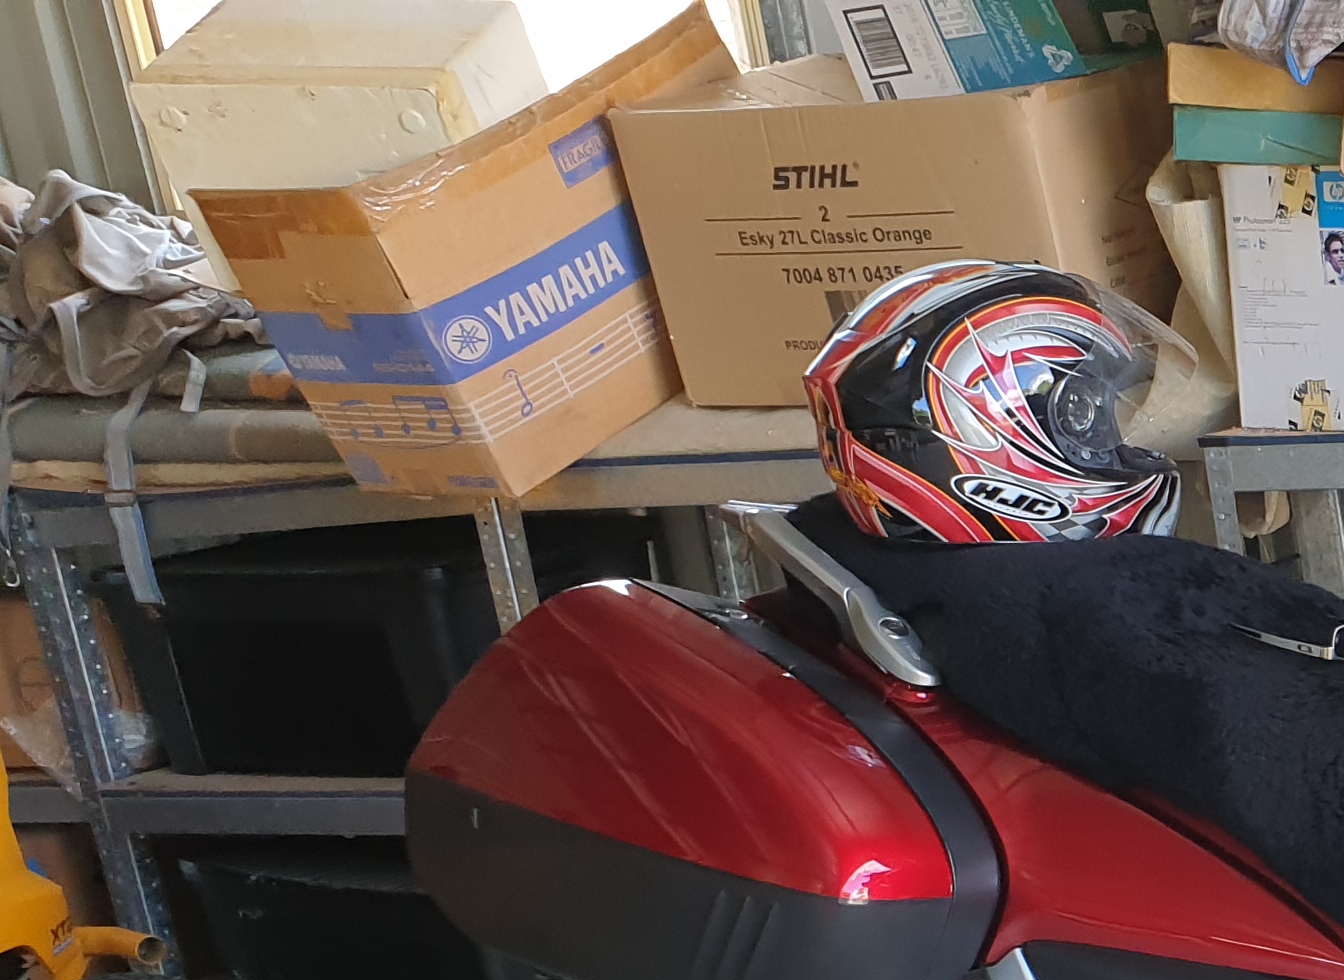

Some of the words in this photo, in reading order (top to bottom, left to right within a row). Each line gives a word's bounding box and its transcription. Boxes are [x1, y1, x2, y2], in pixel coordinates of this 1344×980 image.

[561, 135, 604, 171] FRAGIL
[772, 164, 859, 191] STIHL
[818, 205, 831, 222] 2
[738, 230, 774, 249] Esky
[778, 229, 808, 246] 27L
[810, 227, 868, 245] Classic
[872, 226, 932, 244] Orange
[781, 267, 823, 284] 7004
[828, 265, 856, 283] 871
[863, 264, 904, 283] 0435
[484, 241, 626, 342] YAMAHA
[784, 340, 823, 351] PRODU
[969, 481, 1057, 516] HJC
